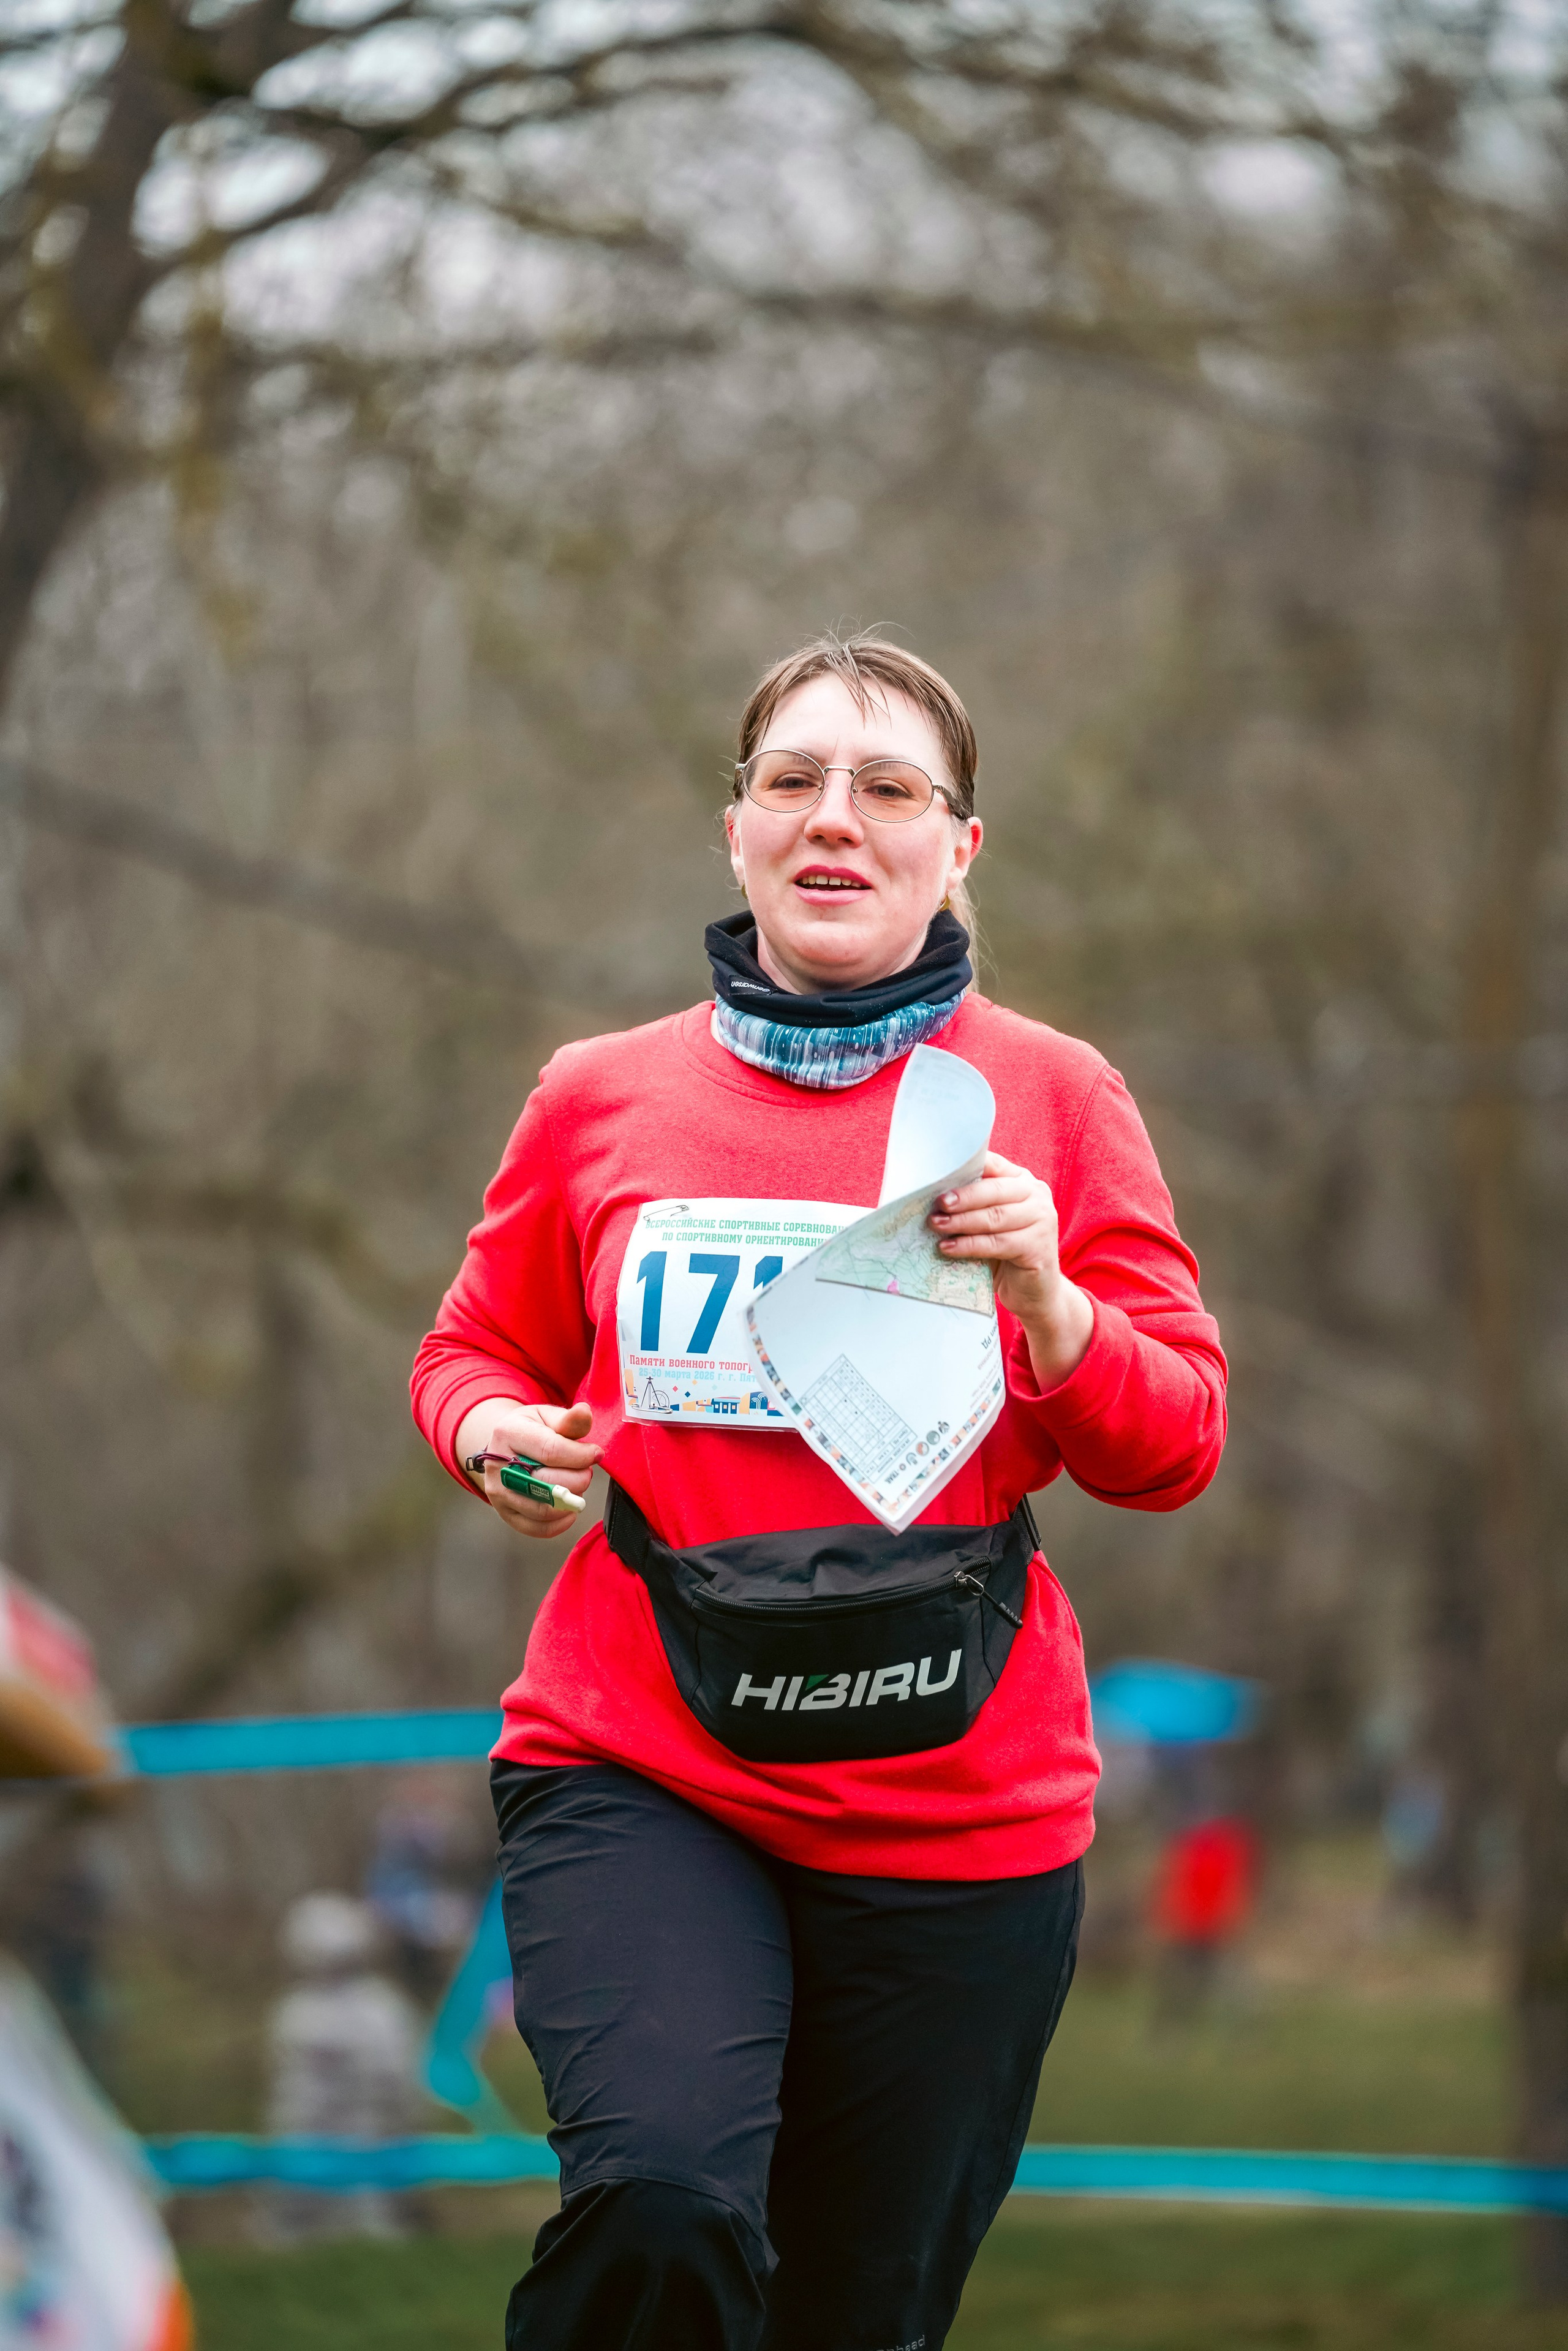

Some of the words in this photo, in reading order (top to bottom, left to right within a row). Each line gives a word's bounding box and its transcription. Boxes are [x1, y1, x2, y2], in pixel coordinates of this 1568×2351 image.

[645, 1217, 716, 1229] ВСЕРОССИЙСКИЕ
[718, 1220, 780, 1231] СПОРТИВНЫЕ
[662, 1232, 673, 1241] ПО
[676, 1232, 743, 1243] СПОРТИВНОМУ
[629, 1354, 665, 1367] Памяти
[668, 1359, 715, 1370] военного
[639, 1367, 662, 1378] 25-30
[665, 1370, 692, 1381] марта
[694, 1370, 715, 1380] 2026
[728, 1373, 736, 1382] г.
[731, 1648, 963, 1711] HIBIRU
